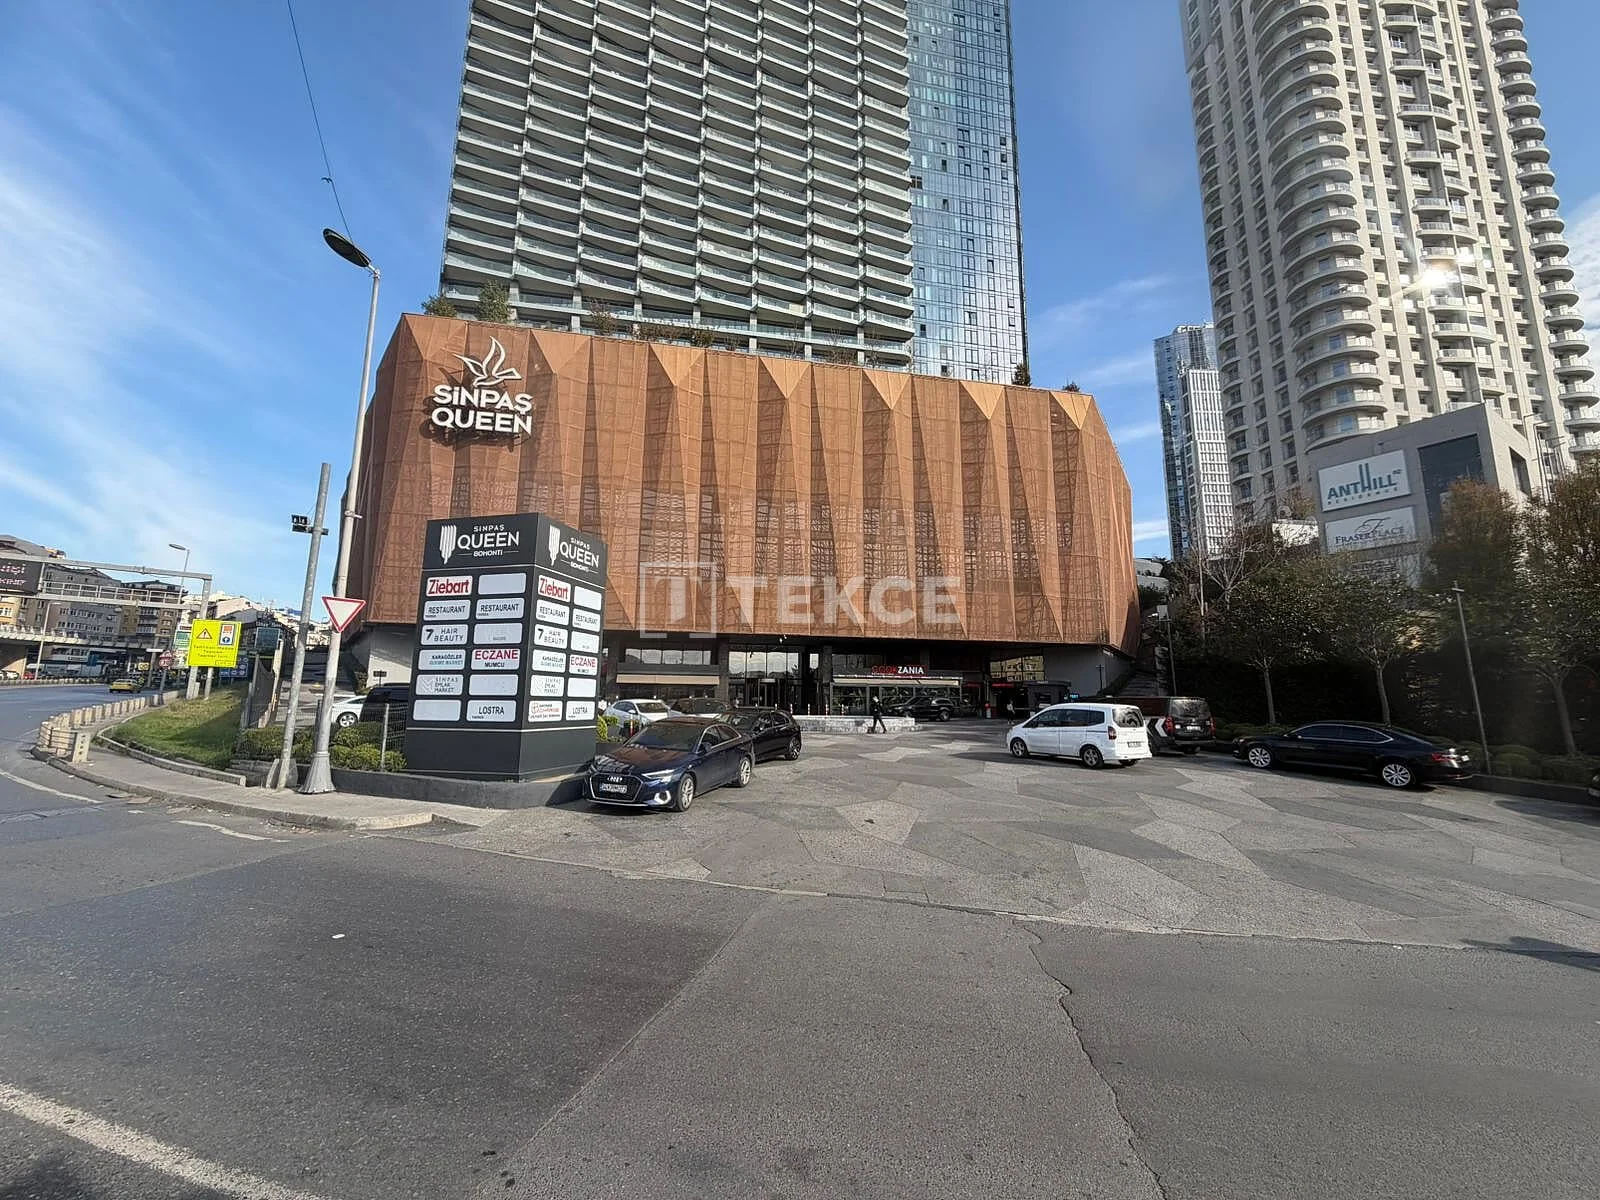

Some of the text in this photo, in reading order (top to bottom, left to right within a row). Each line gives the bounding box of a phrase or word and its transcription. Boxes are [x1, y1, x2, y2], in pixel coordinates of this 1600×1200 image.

[431, 407, 532, 435] QUEEN
[1327, 463, 1397, 500] ANTHILL
[1372, 526, 1405, 539] PLACE
[457, 531, 519, 550] QUEEN
[560, 541, 599, 568] QUEEN
[428, 578, 469, 595] Ziebart
[539, 578, 568, 599] Ziebart
[428, 605, 466, 614] RESTAURANT
[480, 604, 519, 612] RESTAURANT
[539, 606, 566, 618] RESTAURANT
[425, 629, 434, 641] 7
[537, 628, 544, 640] 7
[544, 636, 565, 645] BEAUTY
[474, 649, 519, 661] ECZANE
[570, 656, 597, 668] ECZANE
[478, 706, 505, 715] LOSTRA
[572, 705, 588, 715] LOSTRA
